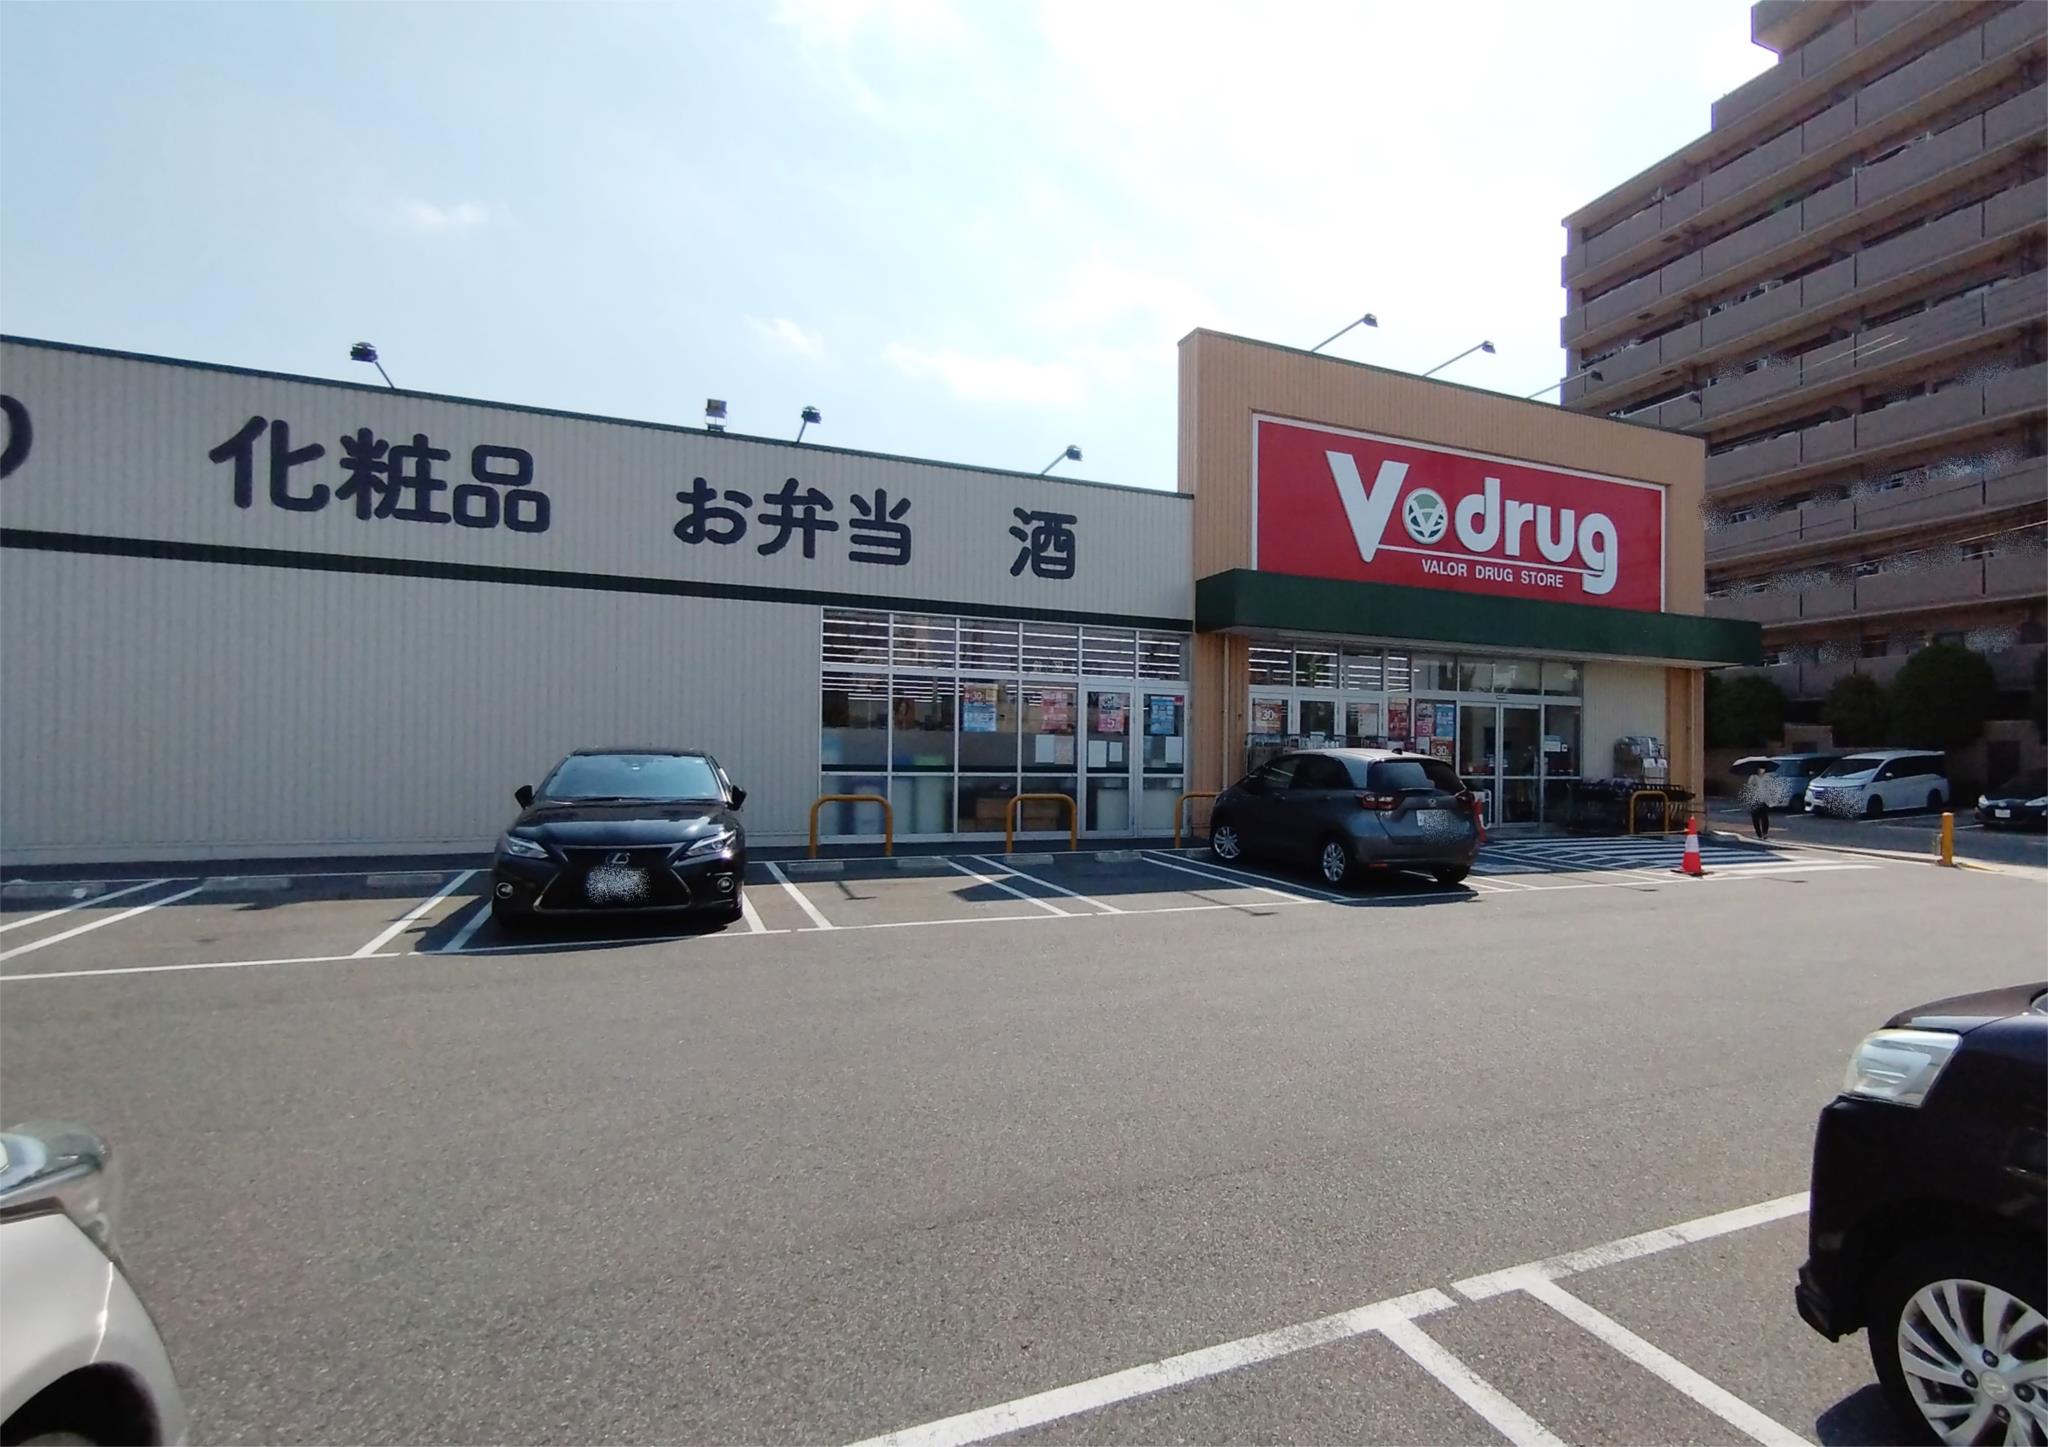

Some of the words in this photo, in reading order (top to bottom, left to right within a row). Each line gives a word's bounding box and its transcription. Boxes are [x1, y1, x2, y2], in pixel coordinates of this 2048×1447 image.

[208, 415, 551, 534] 化粧品
[673, 476, 912, 567] お弁当
[1009, 507, 1078, 580] 酒
[1422, 559, 1467, 577] VALOR
[1475, 565, 1513, 582] DRUG
[1520, 570, 1564, 588] STORE
